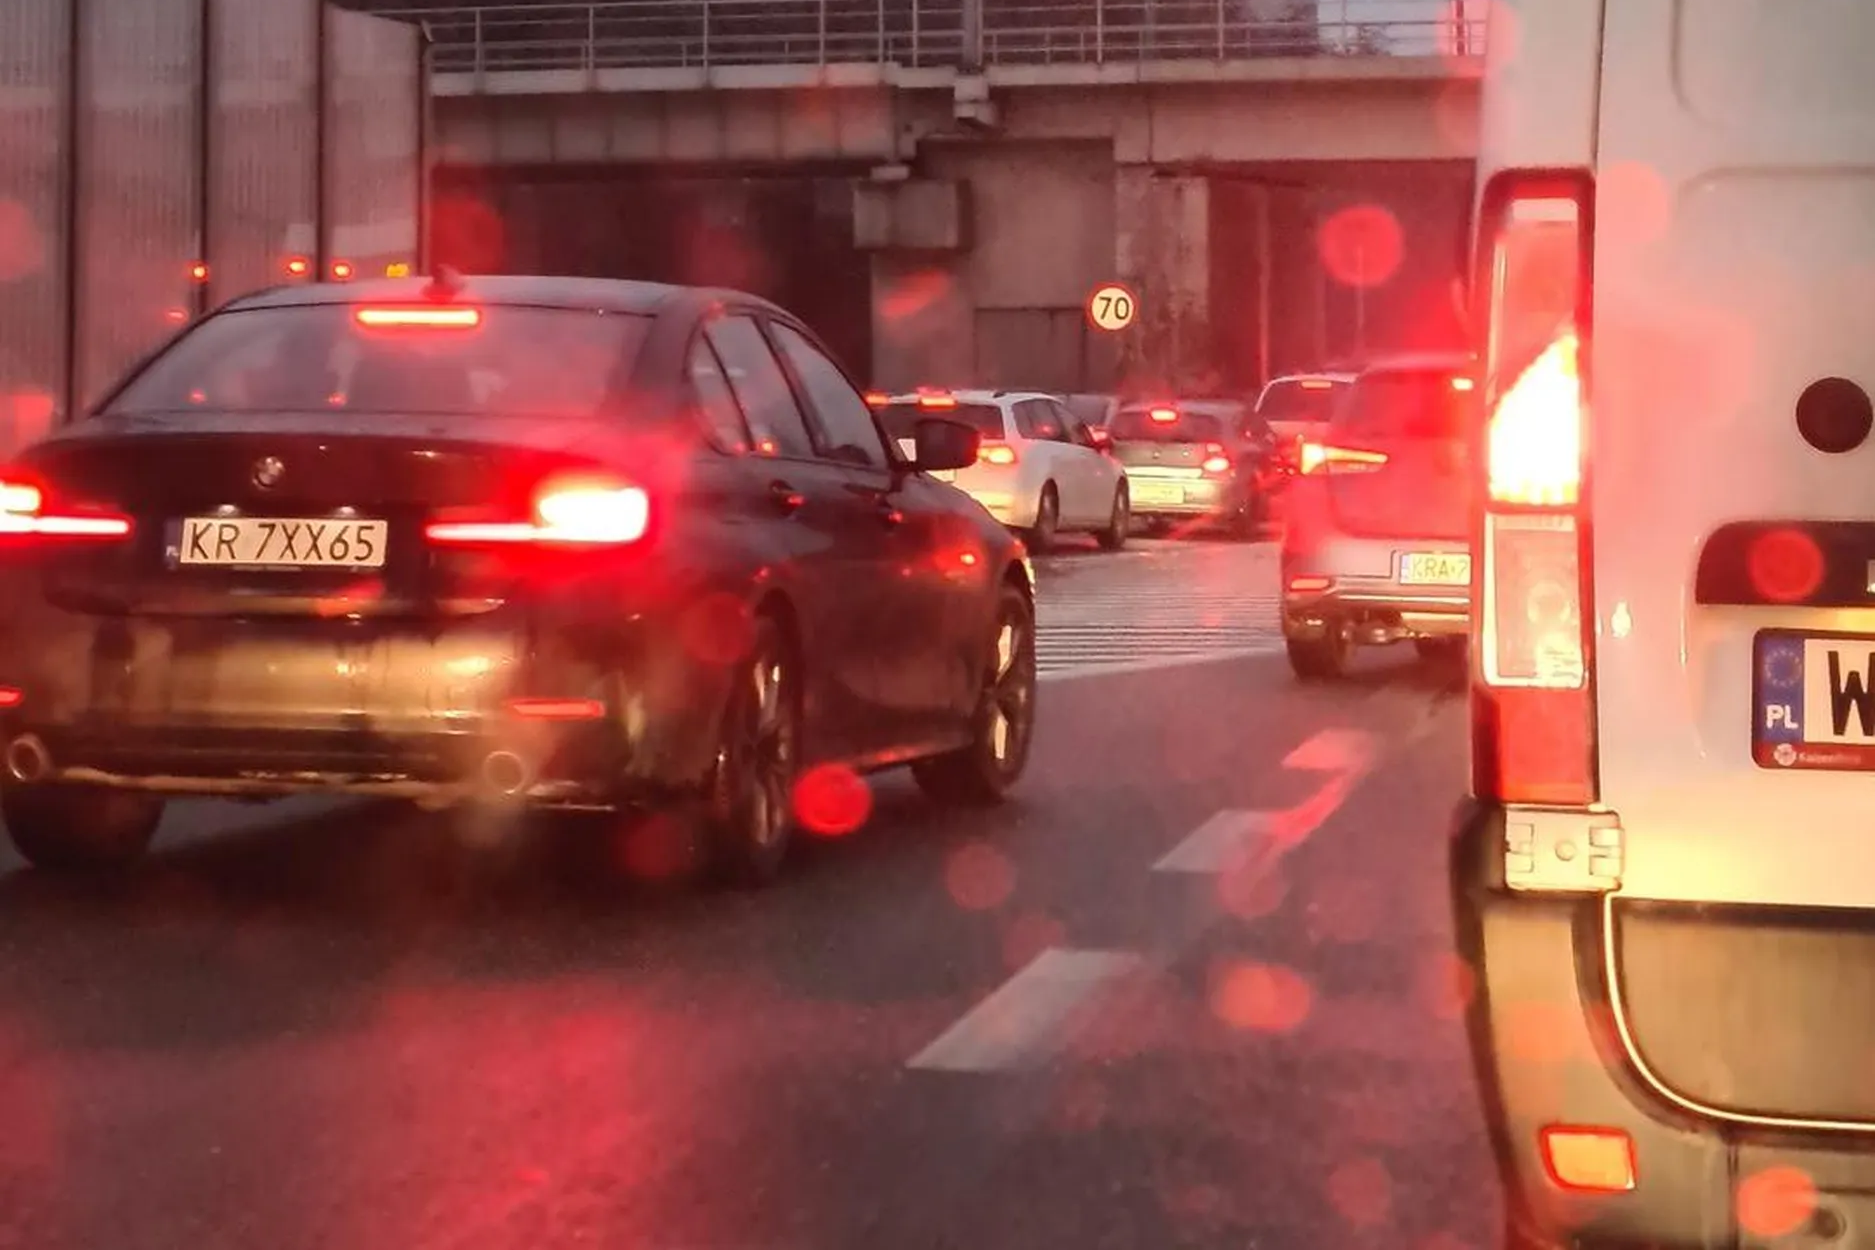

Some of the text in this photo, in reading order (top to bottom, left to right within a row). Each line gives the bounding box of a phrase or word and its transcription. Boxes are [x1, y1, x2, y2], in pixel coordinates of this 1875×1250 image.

[1099, 296, 1129, 320] 70
[190, 523, 374, 562] KR 7XX65
[1412, 557, 1449, 578] KRA
[1766, 704, 1799, 729] PL
